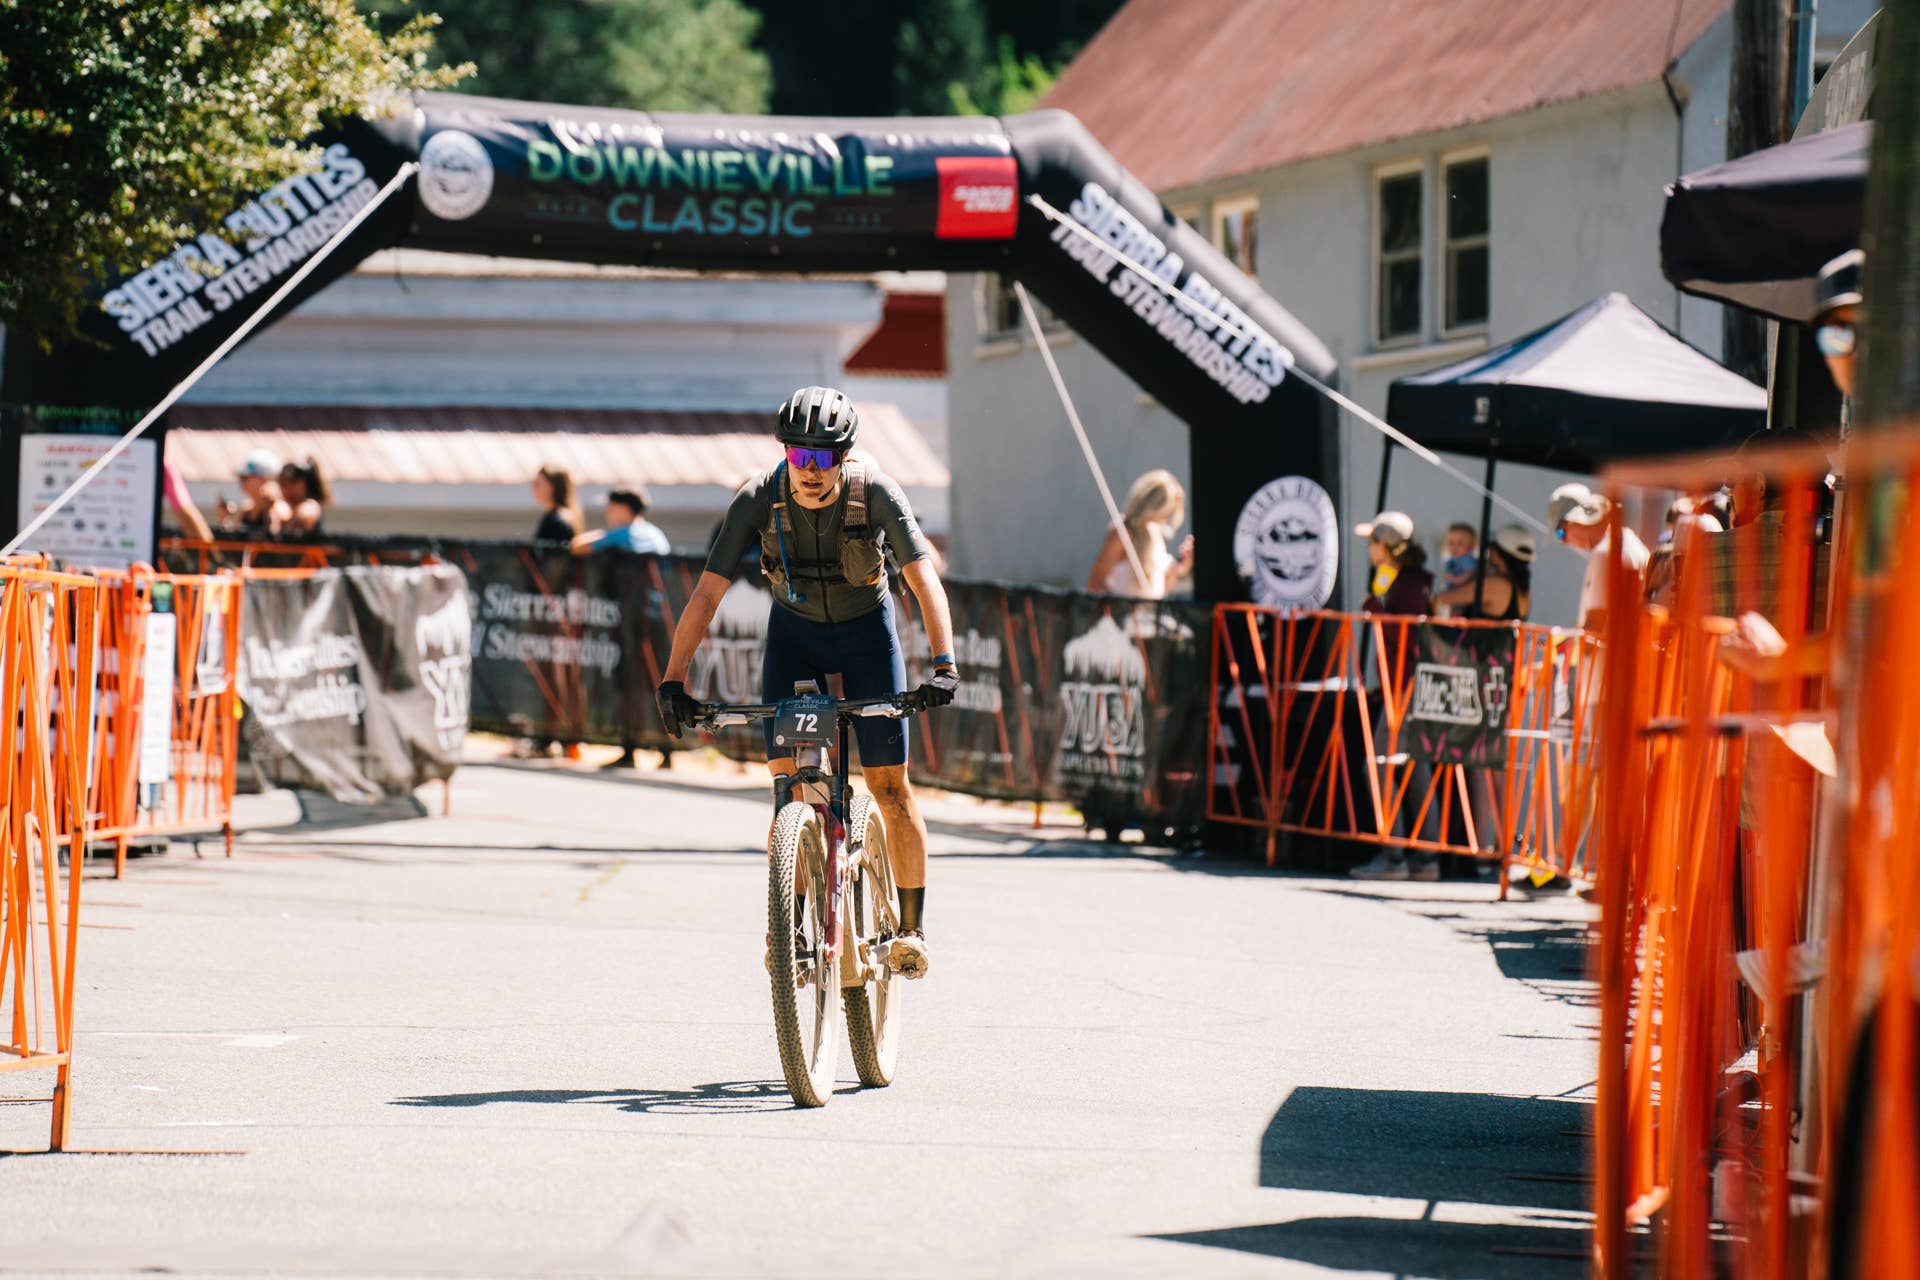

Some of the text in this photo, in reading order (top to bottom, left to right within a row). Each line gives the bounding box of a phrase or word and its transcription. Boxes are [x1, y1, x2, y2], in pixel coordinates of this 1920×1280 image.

[527, 138, 896, 196] DOWNIEVILLE
[606, 193, 826, 238] CLASSIC
[102, 232, 243, 333] SIERRA
[130, 176, 380, 358] TRAIL STEWARDSHIP
[1050, 213, 1272, 405] TRAIL STEWARDSHIP
[1069, 181, 1297, 388] SIERRA BUTTES
[794, 713, 819, 733] 72
[1059, 682, 1145, 757] YUBA
